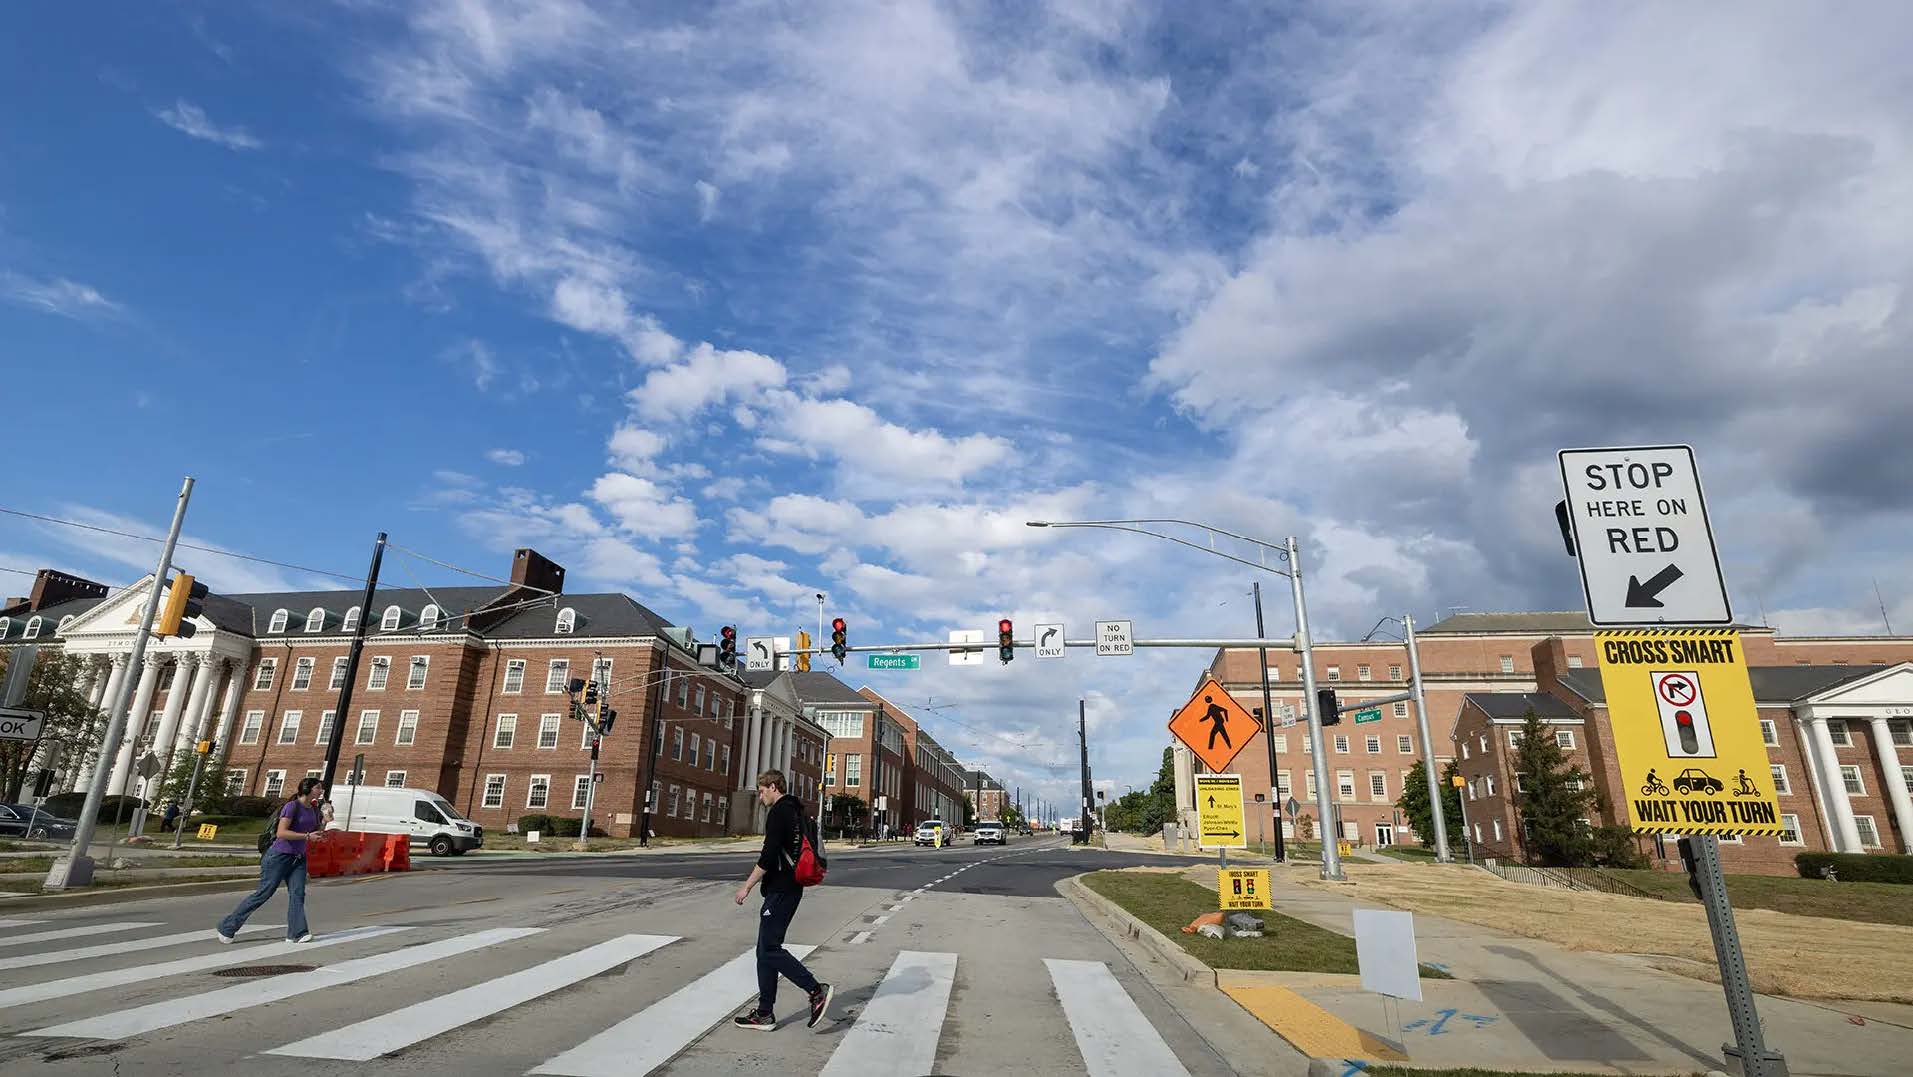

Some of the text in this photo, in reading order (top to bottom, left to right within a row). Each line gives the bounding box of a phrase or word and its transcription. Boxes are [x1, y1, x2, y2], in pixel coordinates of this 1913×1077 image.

[1585, 462, 1673, 490] STOP
[1587, 499, 1687, 517] HERE ON
[1606, 527, 1679, 553] RED
[1107, 624, 1120, 632] NO
[1039, 648, 1061, 656] ONLY
[1099, 644, 1111, 652] ON
[1604, 640, 1735, 664] CROSS SMART
[750, 661, 769, 669] ONLY
[873, 657, 906, 669] Regents
[1, 721, 26, 734] OK
[1634, 800, 1776, 824] WAIT YOUR TURN
